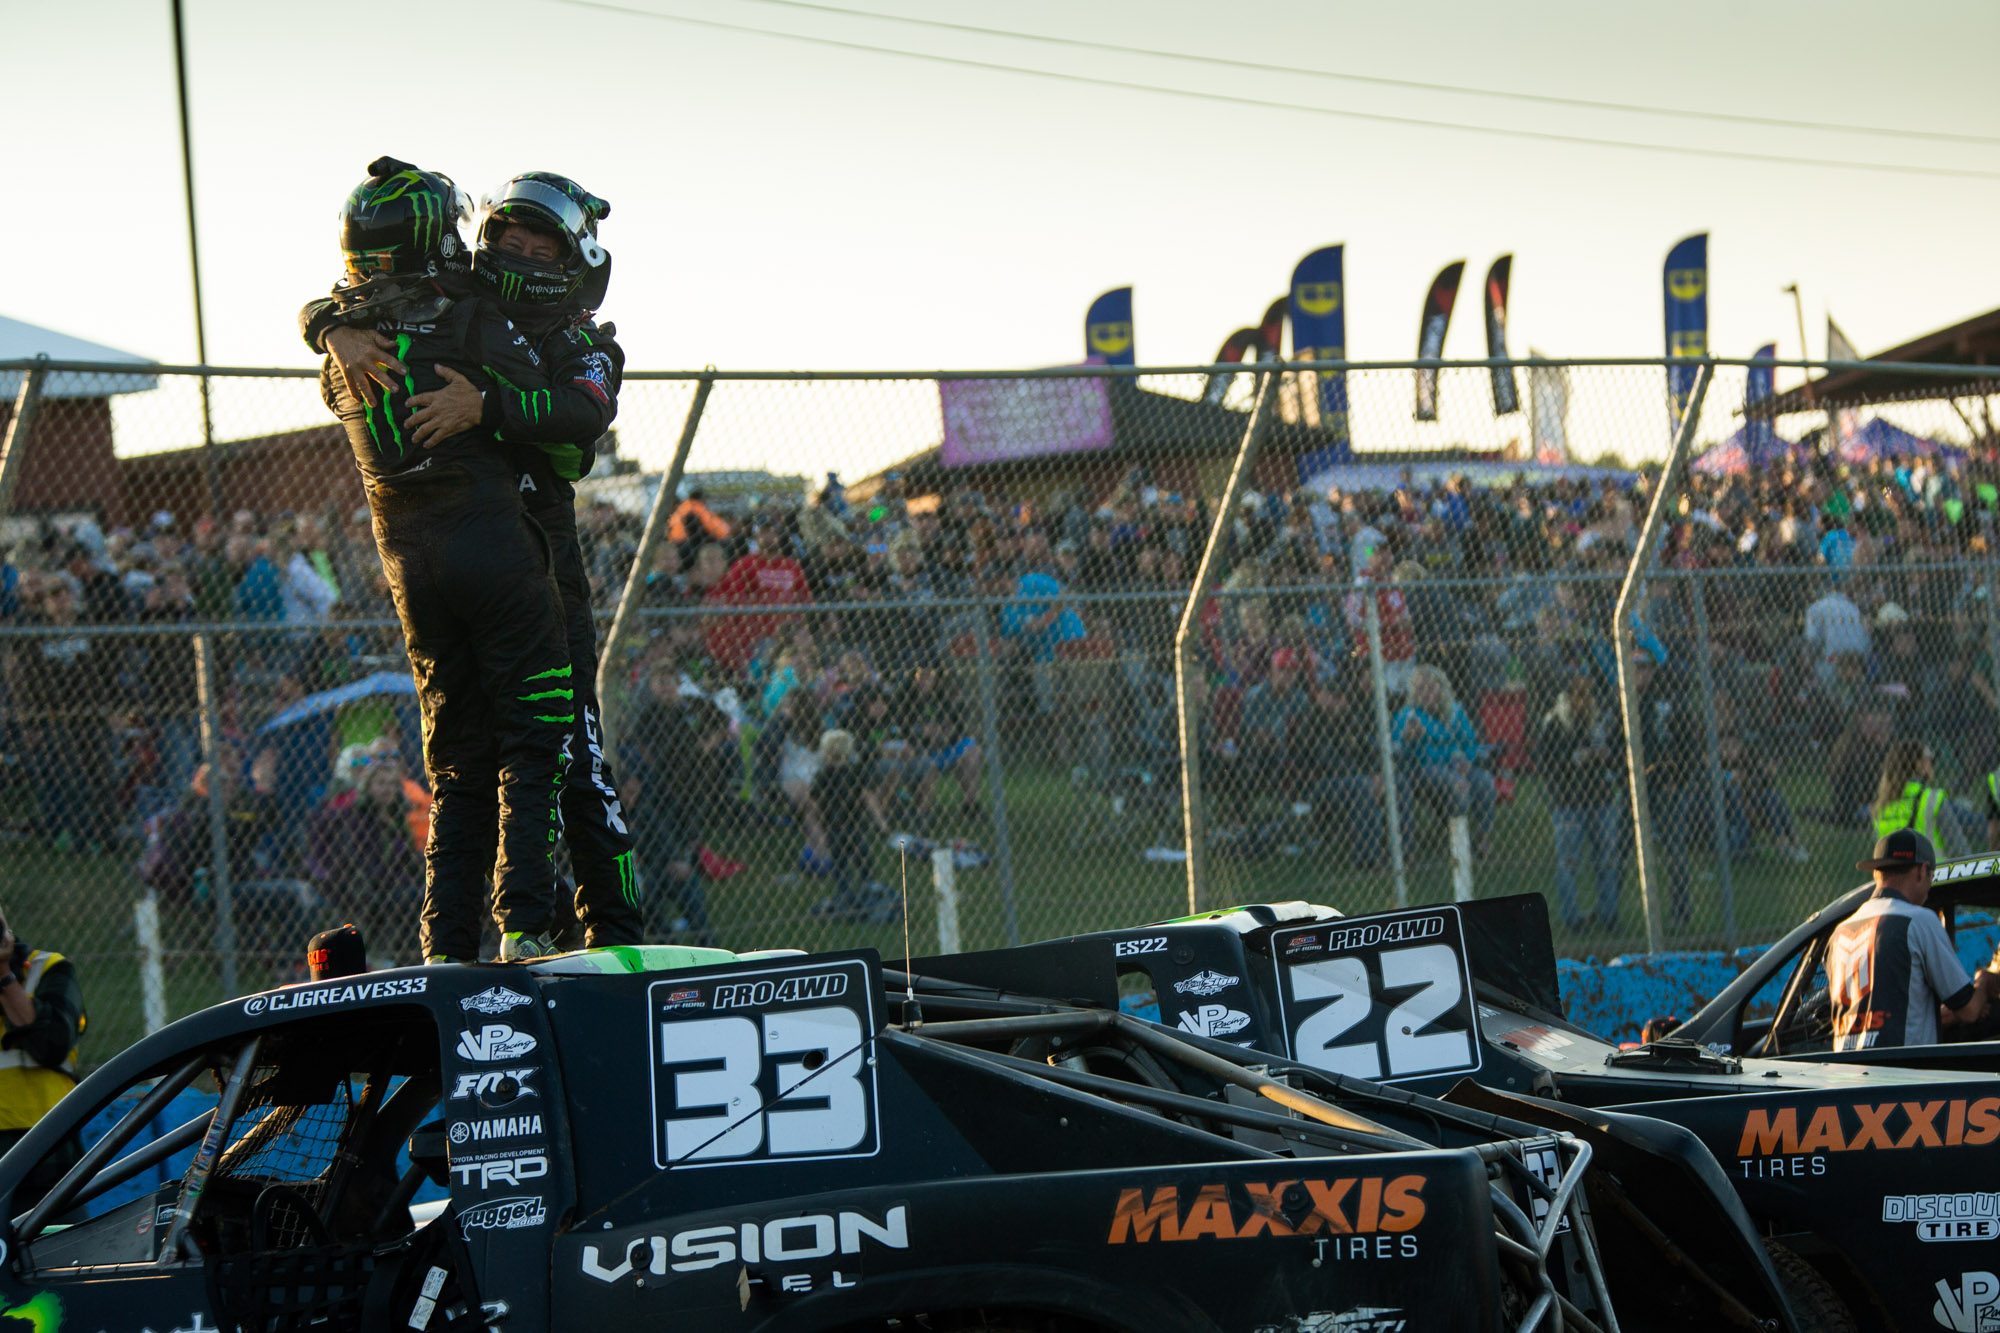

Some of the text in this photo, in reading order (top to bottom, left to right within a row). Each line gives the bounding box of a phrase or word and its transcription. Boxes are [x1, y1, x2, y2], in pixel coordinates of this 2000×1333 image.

[1329, 917, 1444, 951] PRO 4WD
[244, 977, 428, 1016] @CJGREAVES33
[713, 973, 848, 1009] PRO 4WD
[1179, 1004, 1228, 1037] VP
[1289, 944, 1474, 1078] 22
[460, 1024, 513, 1061] VP
[660, 1005, 868, 1162] 33
[470, 1115, 542, 1140] YAMAHA
[1737, 1097, 2000, 1156] MAXXIS
[474, 1152, 499, 1162] RACING
[499, 1148, 545, 1159] DEVELOPMENT
[1740, 1156, 1826, 1178] TIRES
[450, 1156, 548, 1190] TRD
[1107, 1174, 1428, 1244] MAXXIS
[1882, 1192, 2000, 1223] DISCOU
[582, 1206, 909, 1283] VISION
[1926, 1221, 1990, 1238] TIRE
[1315, 1235, 1419, 1261] TIRES
[1935, 1271, 2000, 1333] VP
